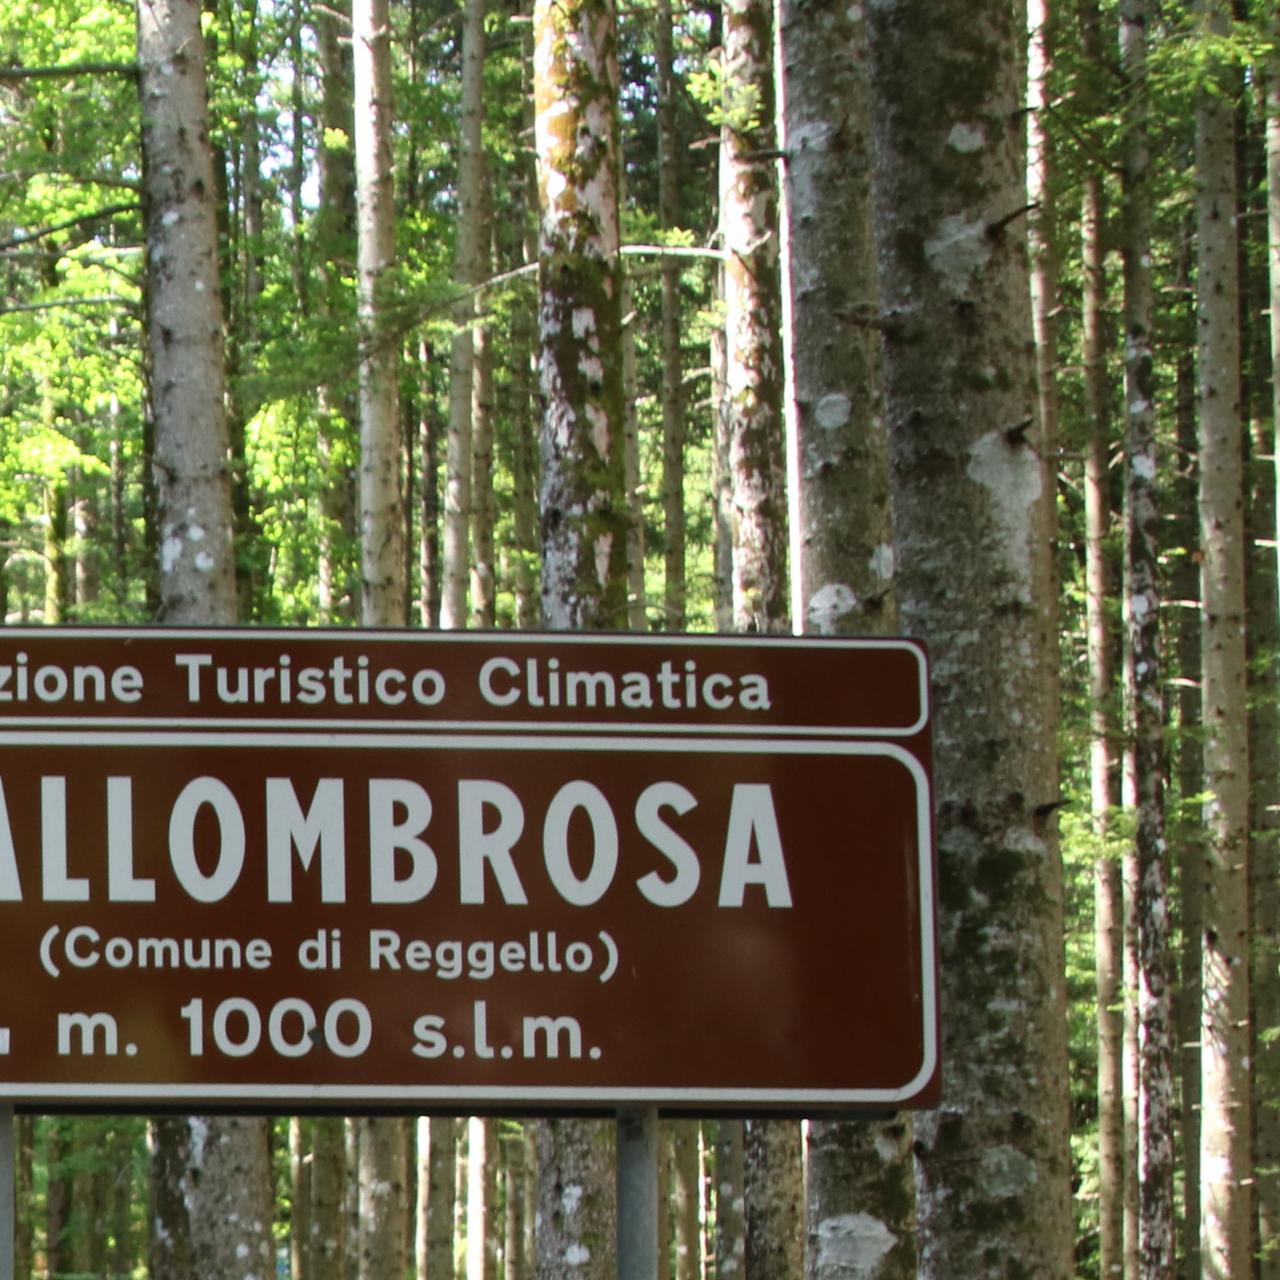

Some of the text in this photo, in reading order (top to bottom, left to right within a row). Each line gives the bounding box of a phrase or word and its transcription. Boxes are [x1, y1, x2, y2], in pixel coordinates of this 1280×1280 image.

[175, 654, 446, 705] Turistico
[478, 656, 771, 710] Climatica
[39, 925, 619, 983] (Comune di Reggello)
[57, 997, 602, 1060] m. 1000 s.l.m.
